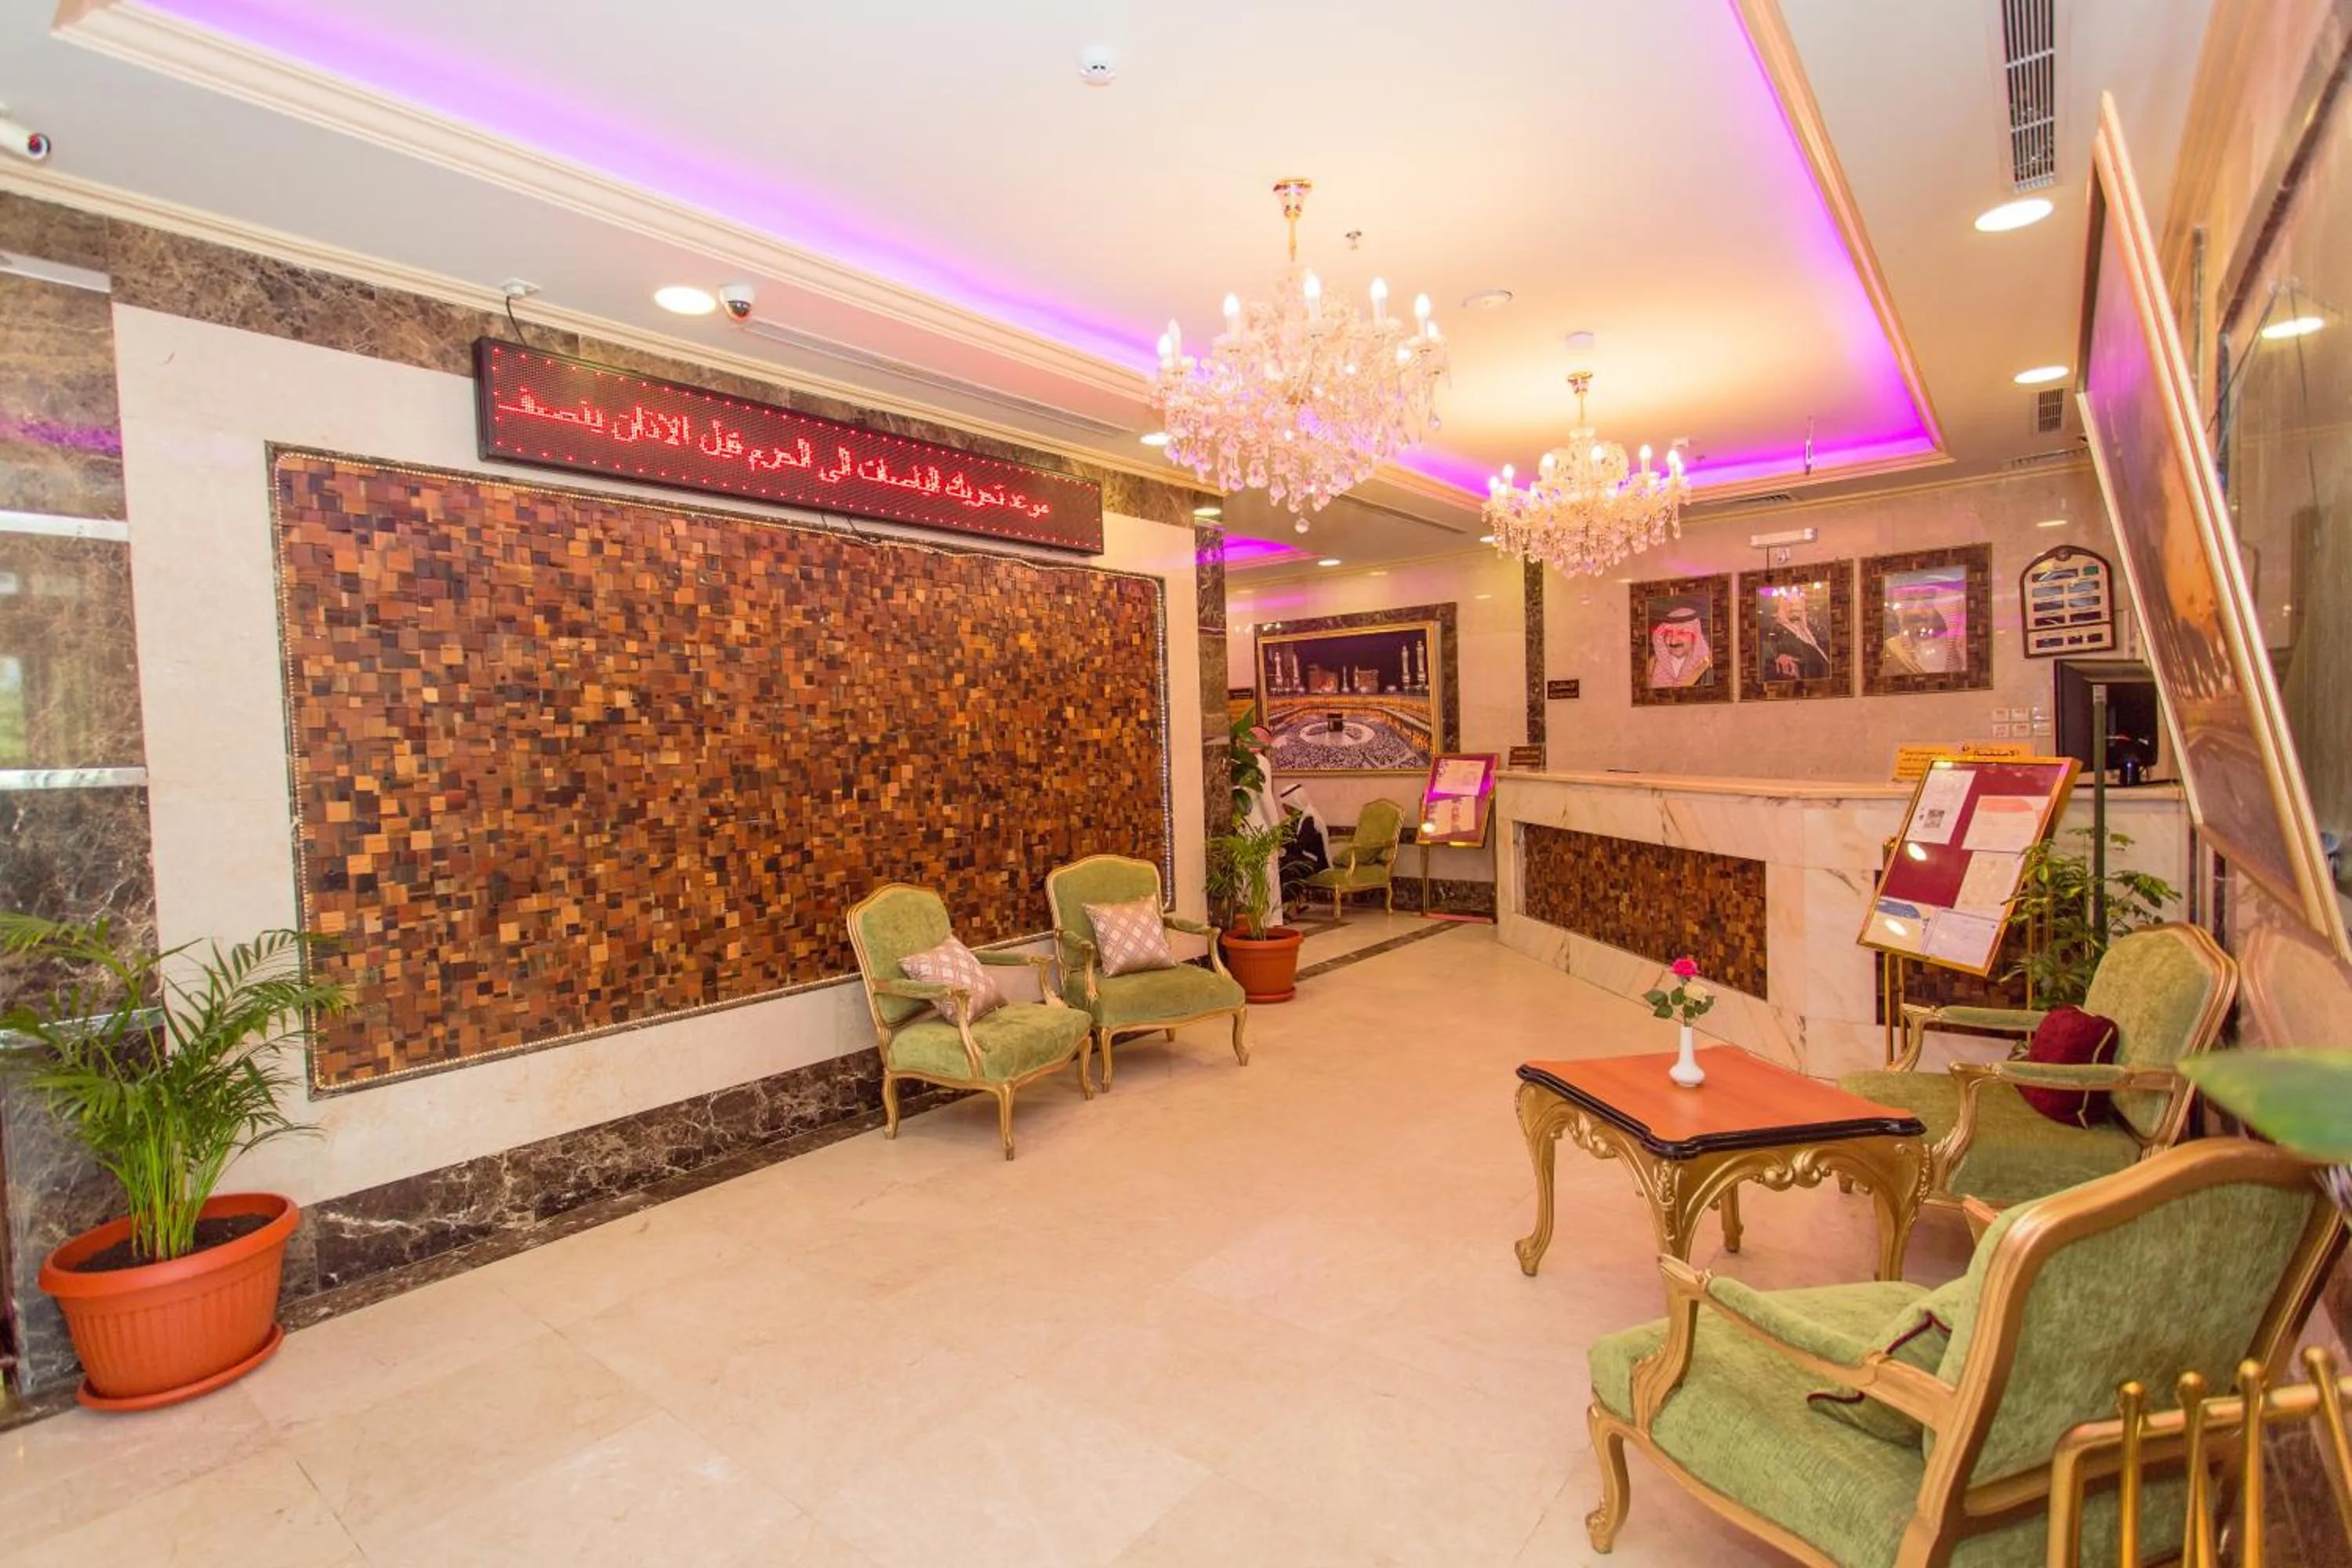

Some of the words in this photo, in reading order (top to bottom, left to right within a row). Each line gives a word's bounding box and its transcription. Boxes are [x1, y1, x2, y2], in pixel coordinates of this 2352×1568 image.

[699, 419, 743, 458] قبل
[748, 438, 812, 472] الحرم
[857, 458, 941, 496] الباصات
